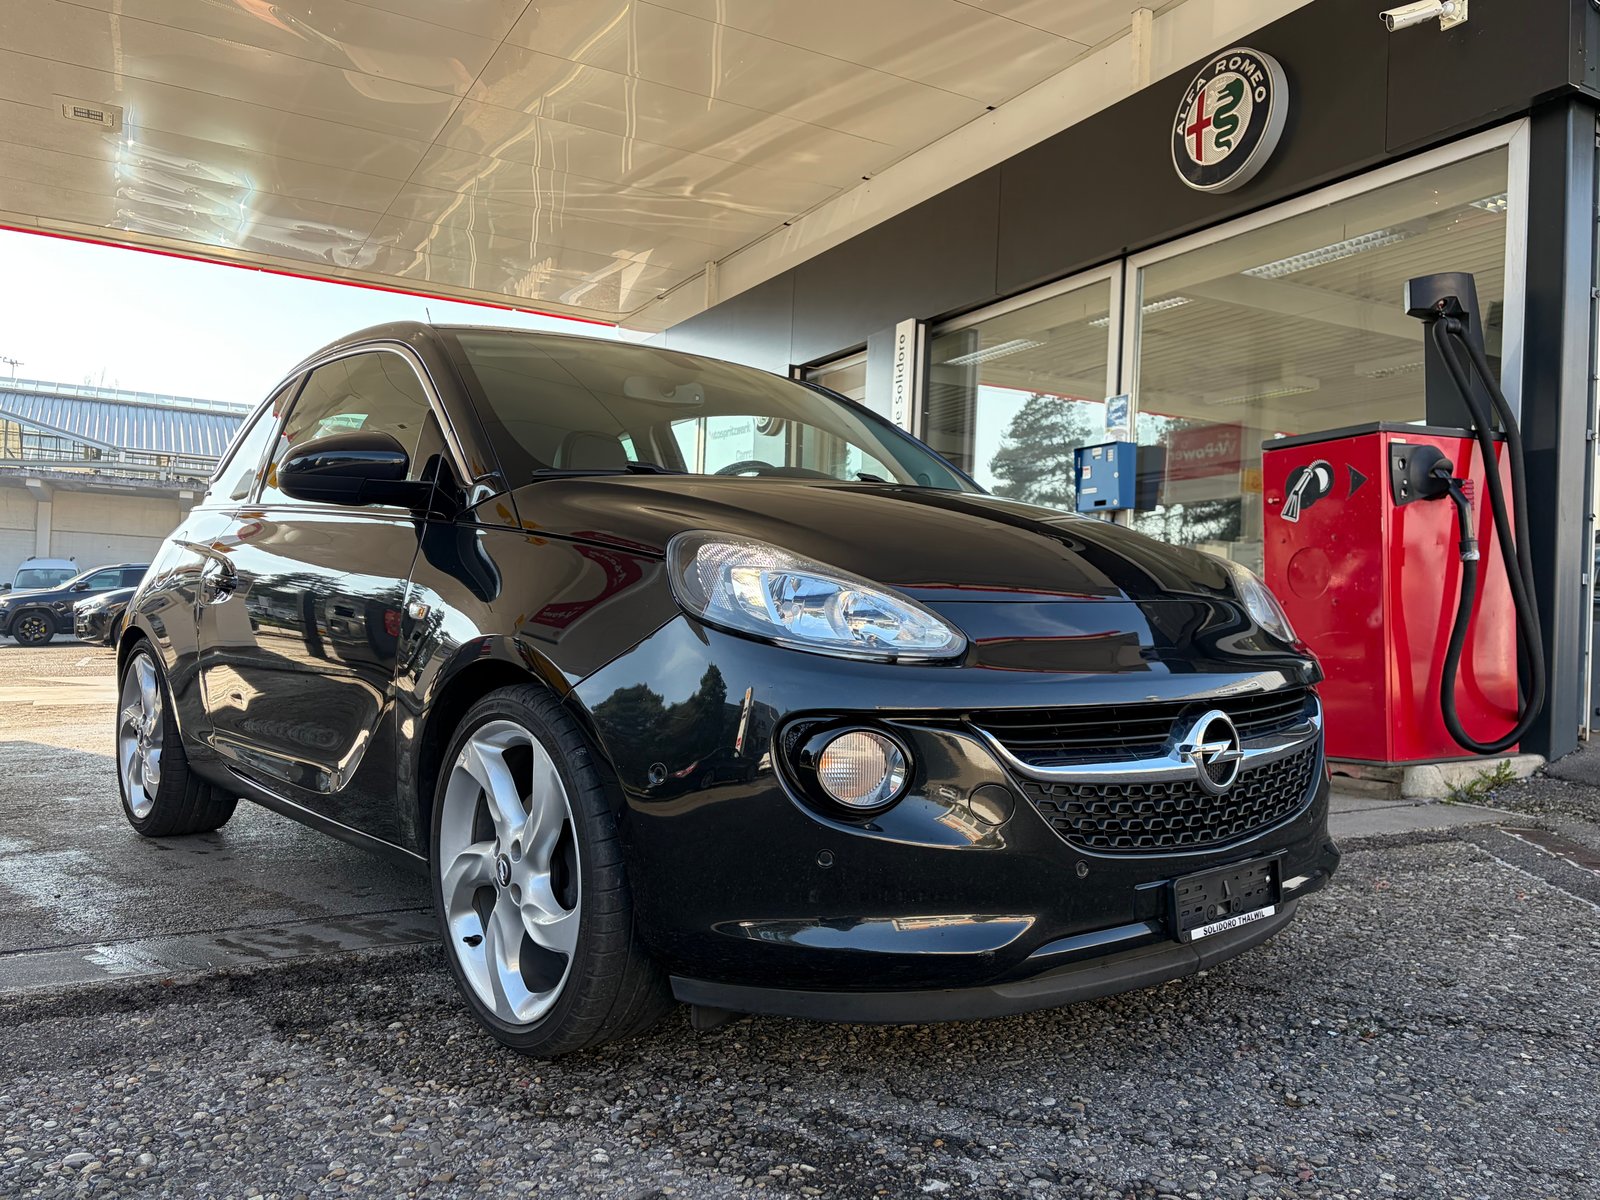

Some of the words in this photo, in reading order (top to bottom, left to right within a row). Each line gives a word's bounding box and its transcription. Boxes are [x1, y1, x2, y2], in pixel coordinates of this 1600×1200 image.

[1177, 78, 1207, 135] ALFA
[1215, 56, 1267, 103] ROMEO
[895, 334, 906, 405] Solidoro
[1203, 919, 1237, 936] SOLIDORO
[1238, 909, 1265, 925] THALWIL
